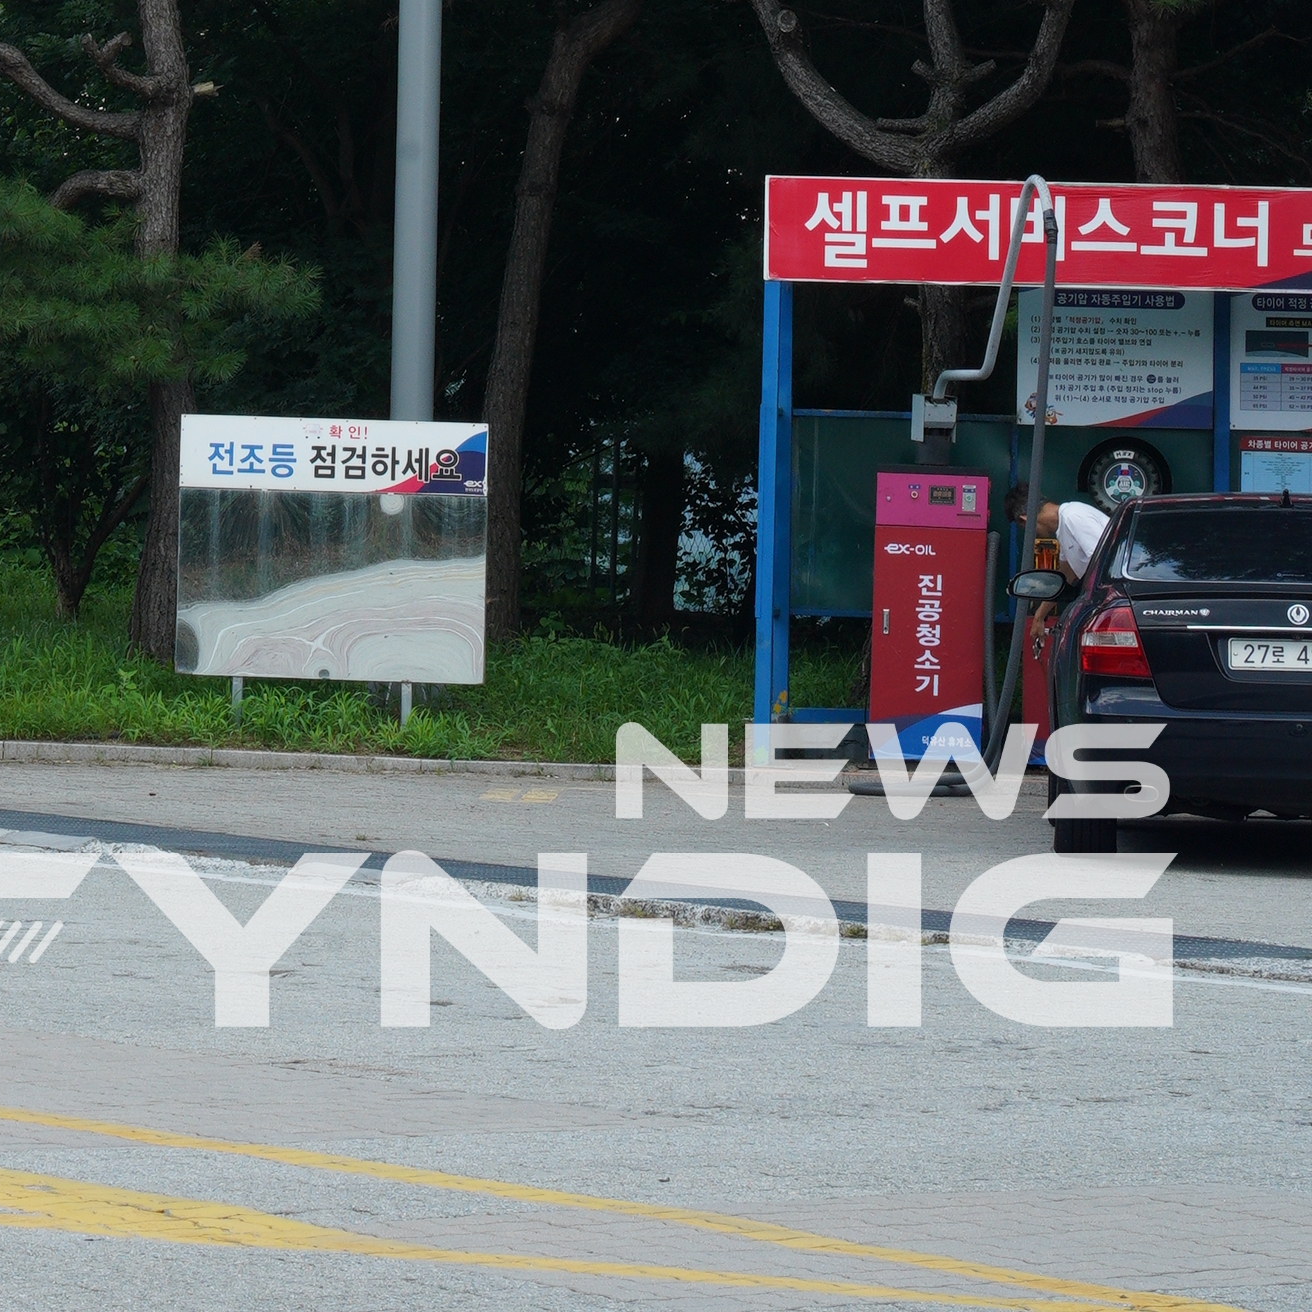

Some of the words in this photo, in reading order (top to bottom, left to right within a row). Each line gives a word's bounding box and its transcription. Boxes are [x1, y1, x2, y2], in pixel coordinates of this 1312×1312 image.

[804, 190, 1269, 267] 셀프서비스코너
[1057, 293, 1088, 305] 공기압
[1091, 294, 1141, 306] 자동주입기
[1145, 295, 1175, 307] 사용법
[1256, 297, 1285, 309] 타이어
[1288, 297, 1307, 309] 적정
[1051, 337, 1075, 345] 기주입기
[1147, 386, 1164, 394] stop
[1274, 440, 1298, 450] 타이어
[207, 441, 297, 478] 전조등
[309, 443, 461, 484] 점검하세요
[1142, 609, 1199, 617] CHAIRMAN
[914, 574, 943, 697] 진공청소기
[1243, 644, 1285, 664] 27로
[1296, 645, 1312, 665] 4
